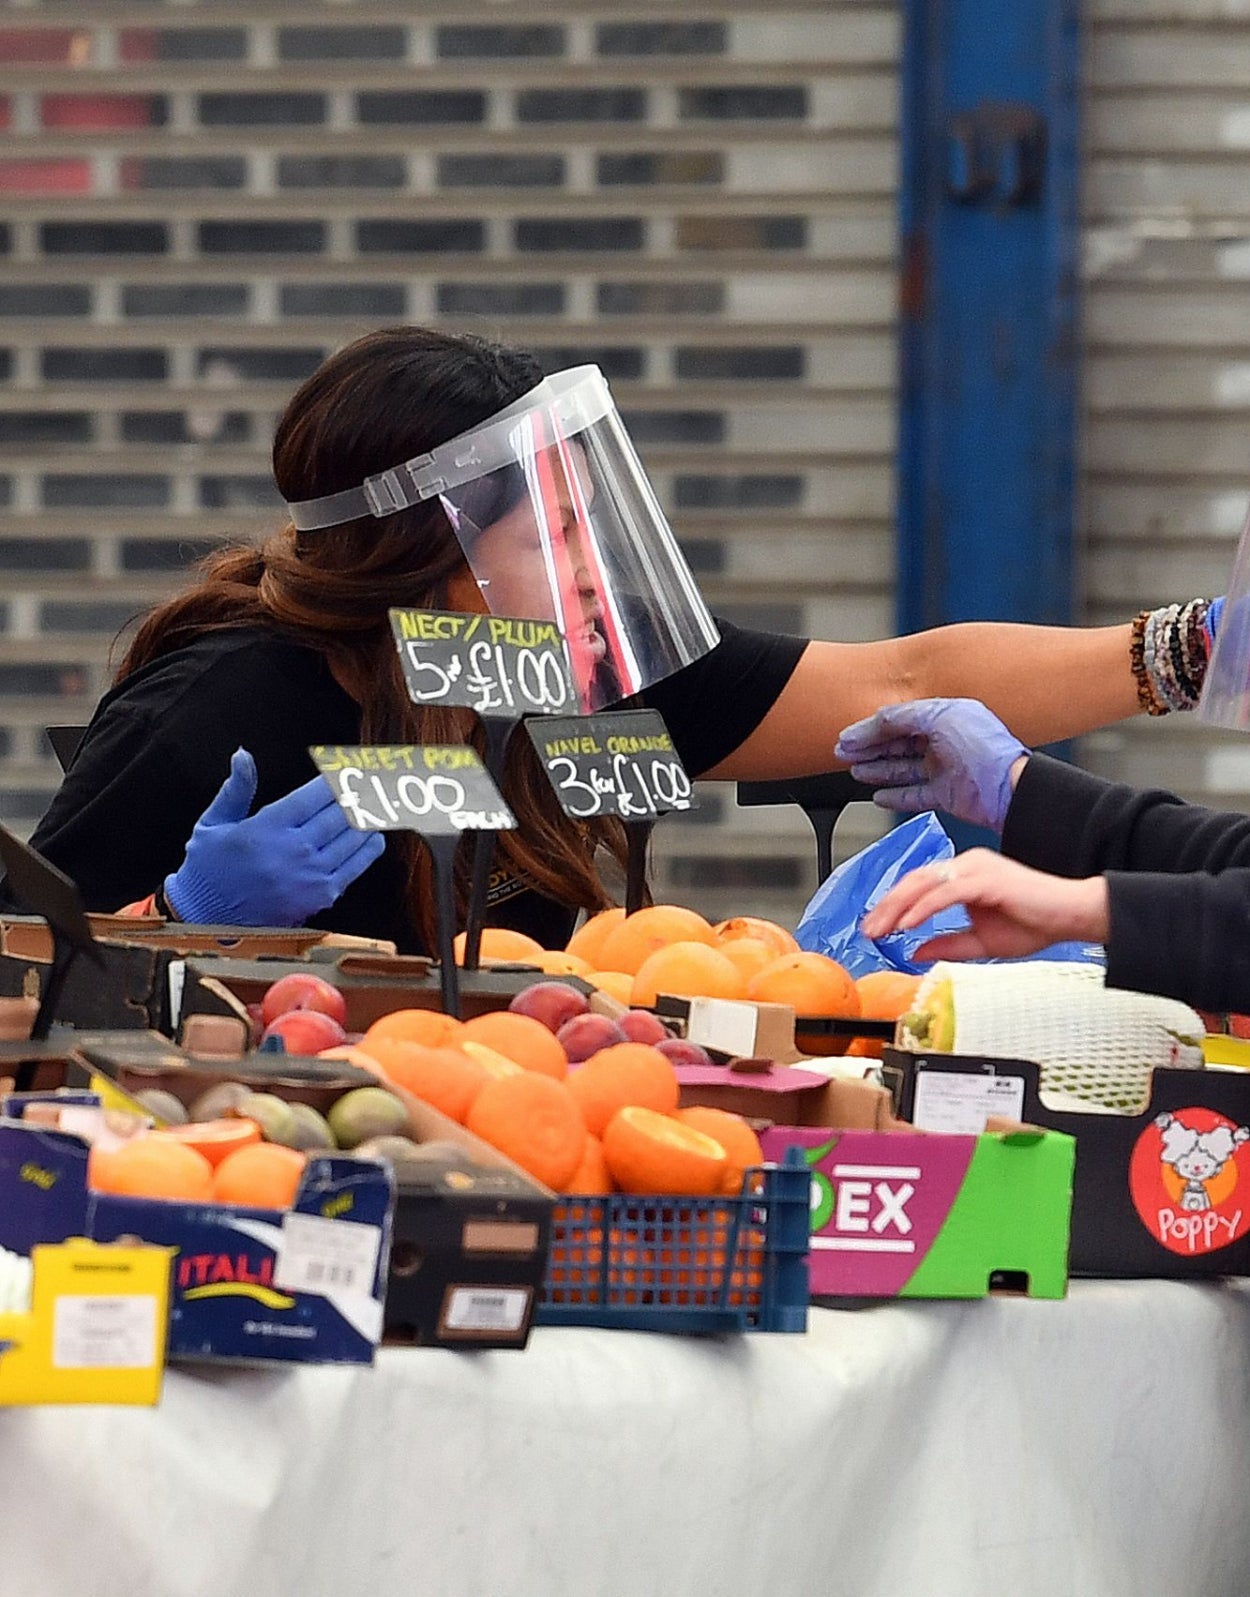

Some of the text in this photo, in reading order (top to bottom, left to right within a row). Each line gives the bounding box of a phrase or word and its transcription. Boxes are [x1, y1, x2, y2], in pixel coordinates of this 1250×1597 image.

[399, 611, 562, 648] NECT/ PLUM
[466, 640, 567, 712] £1.00
[545, 736, 602, 759] NAVEL
[339, 766, 466, 829] £1.00
[547, 757, 602, 817] 3
[613, 753, 692, 816] £1.00
[178, 1253, 295, 1295] ITALI
